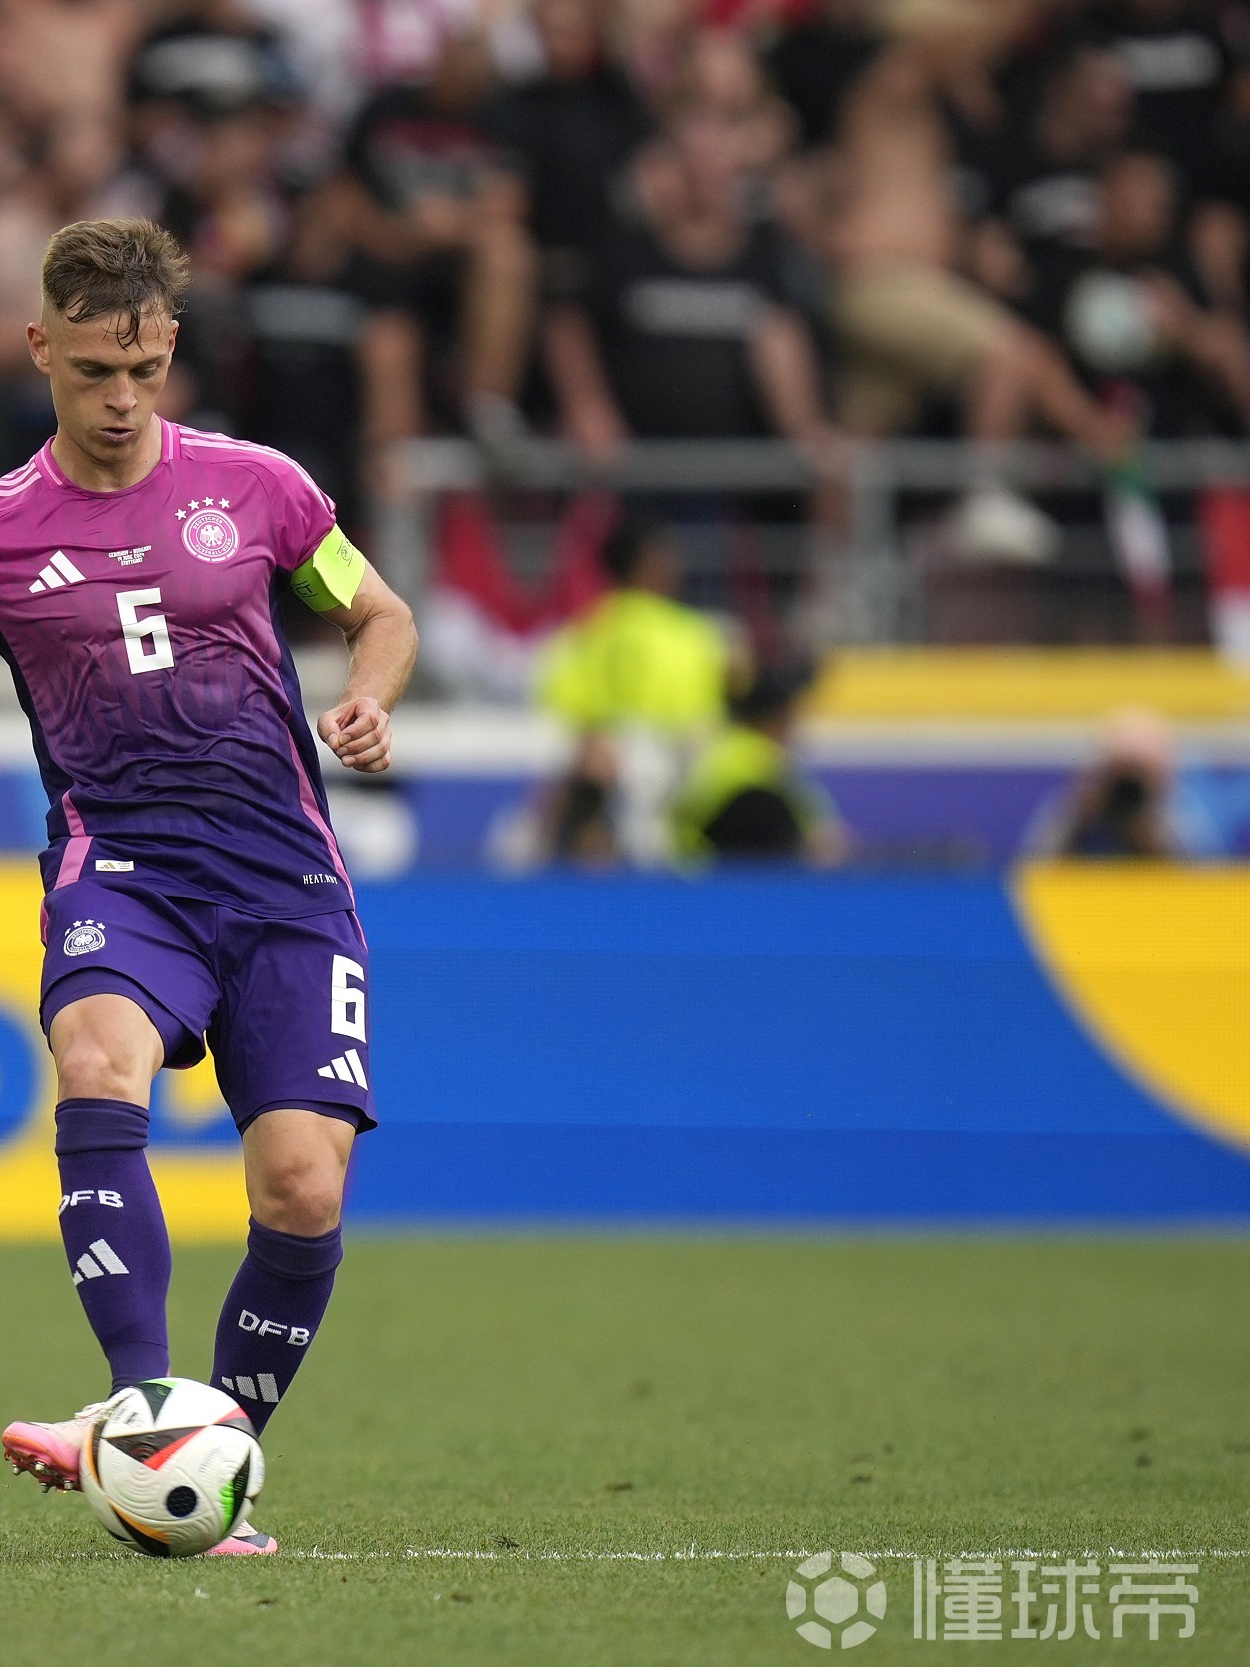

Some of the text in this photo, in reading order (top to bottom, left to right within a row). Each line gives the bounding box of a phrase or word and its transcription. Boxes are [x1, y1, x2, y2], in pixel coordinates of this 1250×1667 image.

[115, 587, 175, 675] 6
[331, 953, 367, 1044] 6
[238, 1309, 310, 1346] DFB
